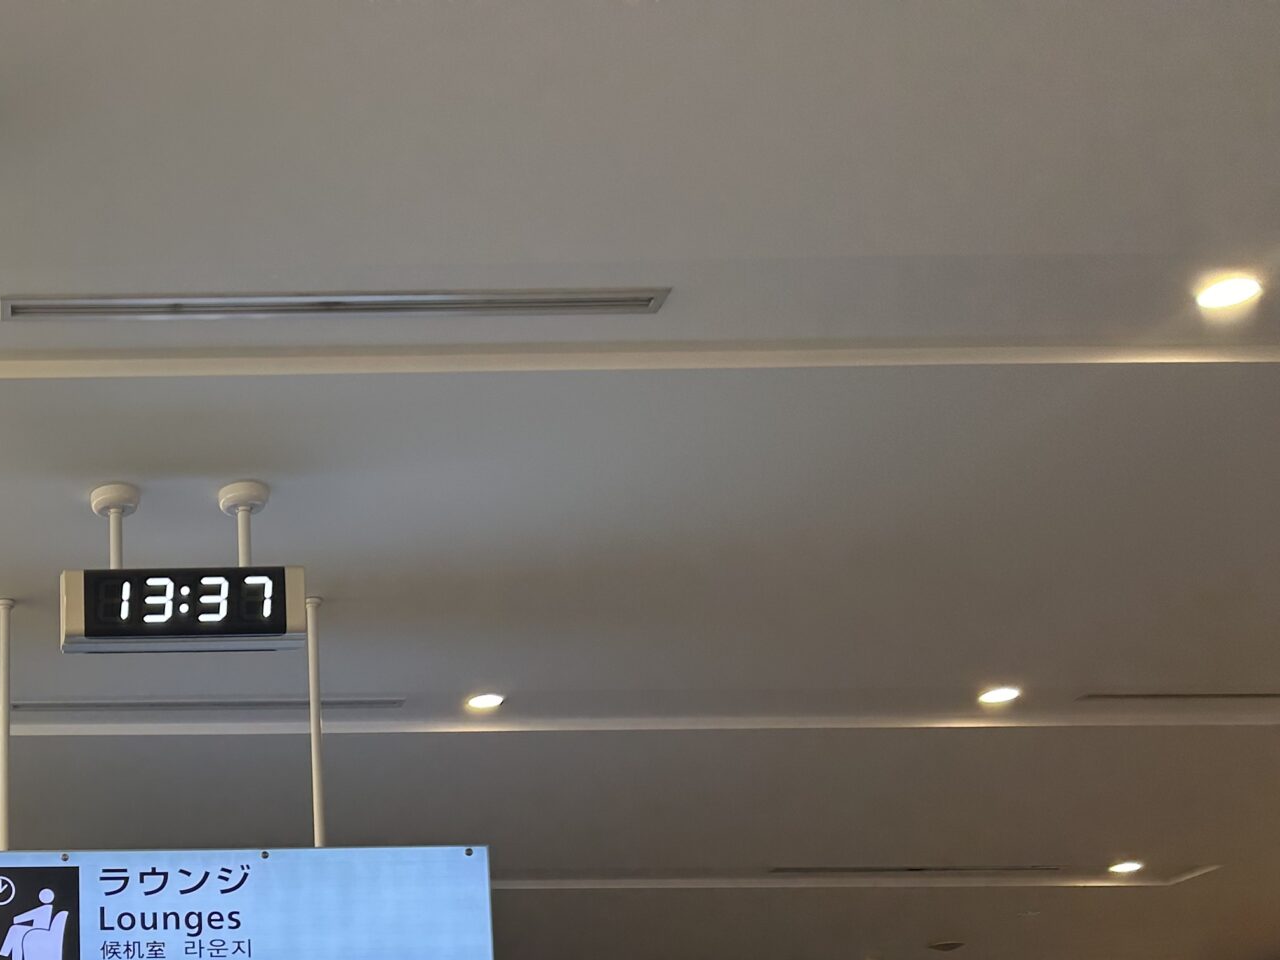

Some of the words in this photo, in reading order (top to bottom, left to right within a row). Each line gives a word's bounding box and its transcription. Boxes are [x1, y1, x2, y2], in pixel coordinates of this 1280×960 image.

[120, 576, 273, 623] 13:37
[99, 864, 251, 896] ラウンジ
[99, 906, 241, 937] Lounges
[100, 940, 166, 960] 候机室
[184, 938, 252, 959] 라운지
